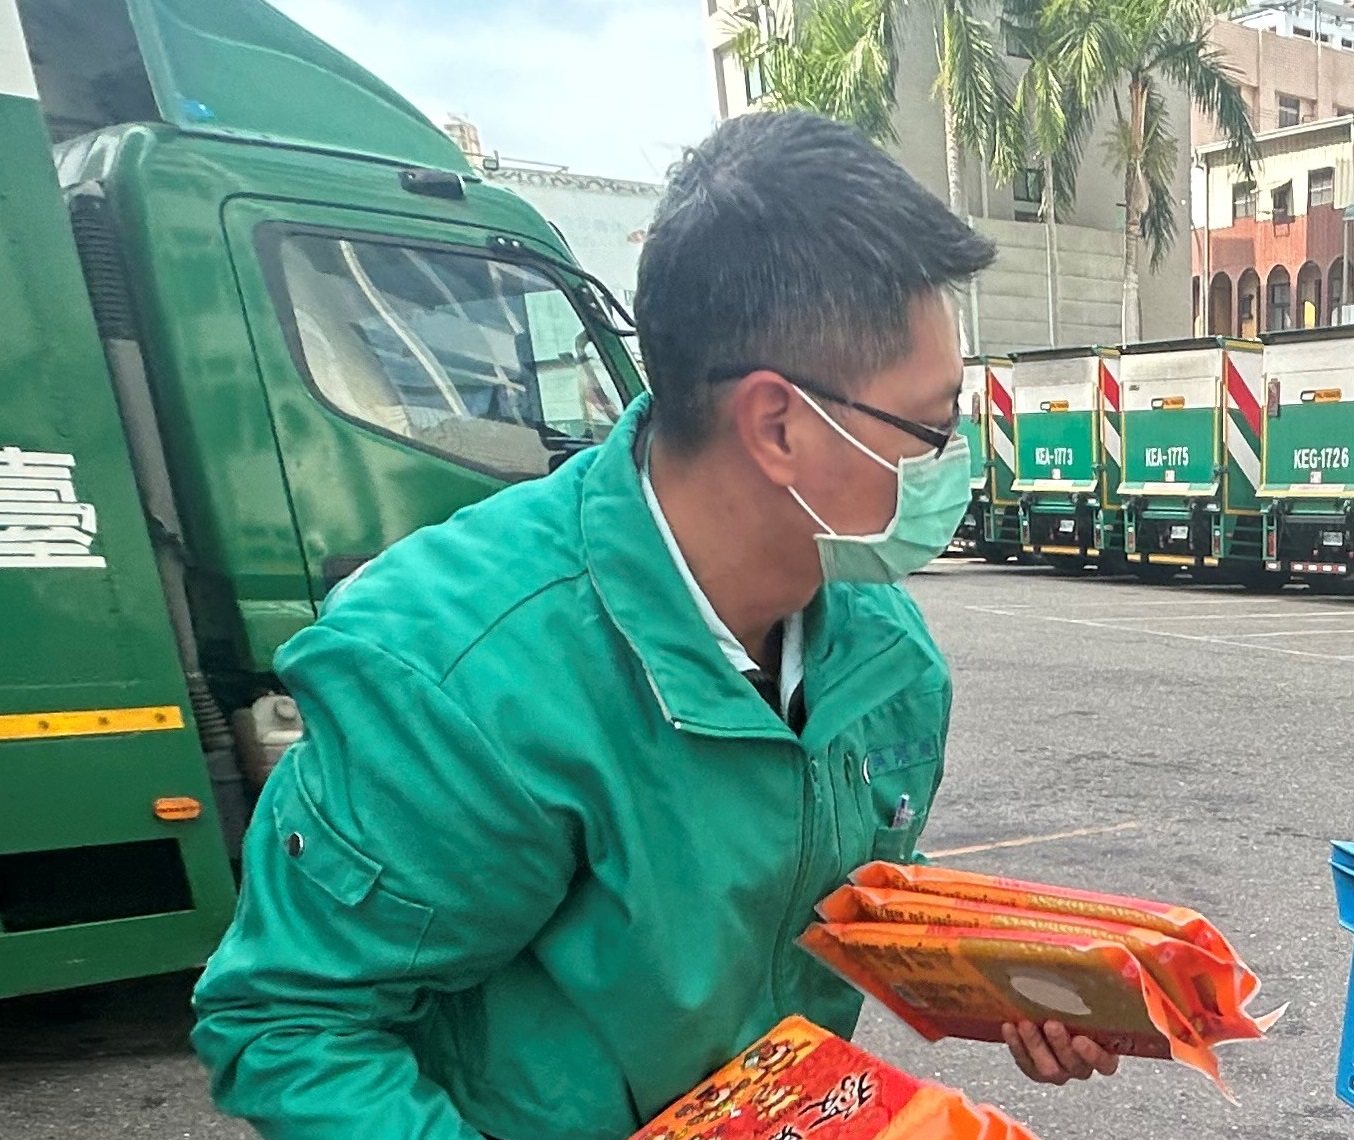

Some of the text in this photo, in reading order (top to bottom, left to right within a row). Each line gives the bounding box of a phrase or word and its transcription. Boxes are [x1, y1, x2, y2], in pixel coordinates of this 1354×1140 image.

[1035, 447, 1073, 466] KEA-1773
[1145, 446, 1189, 467] KEA-1775
[1293, 446, 1350, 470] KEG-1726
